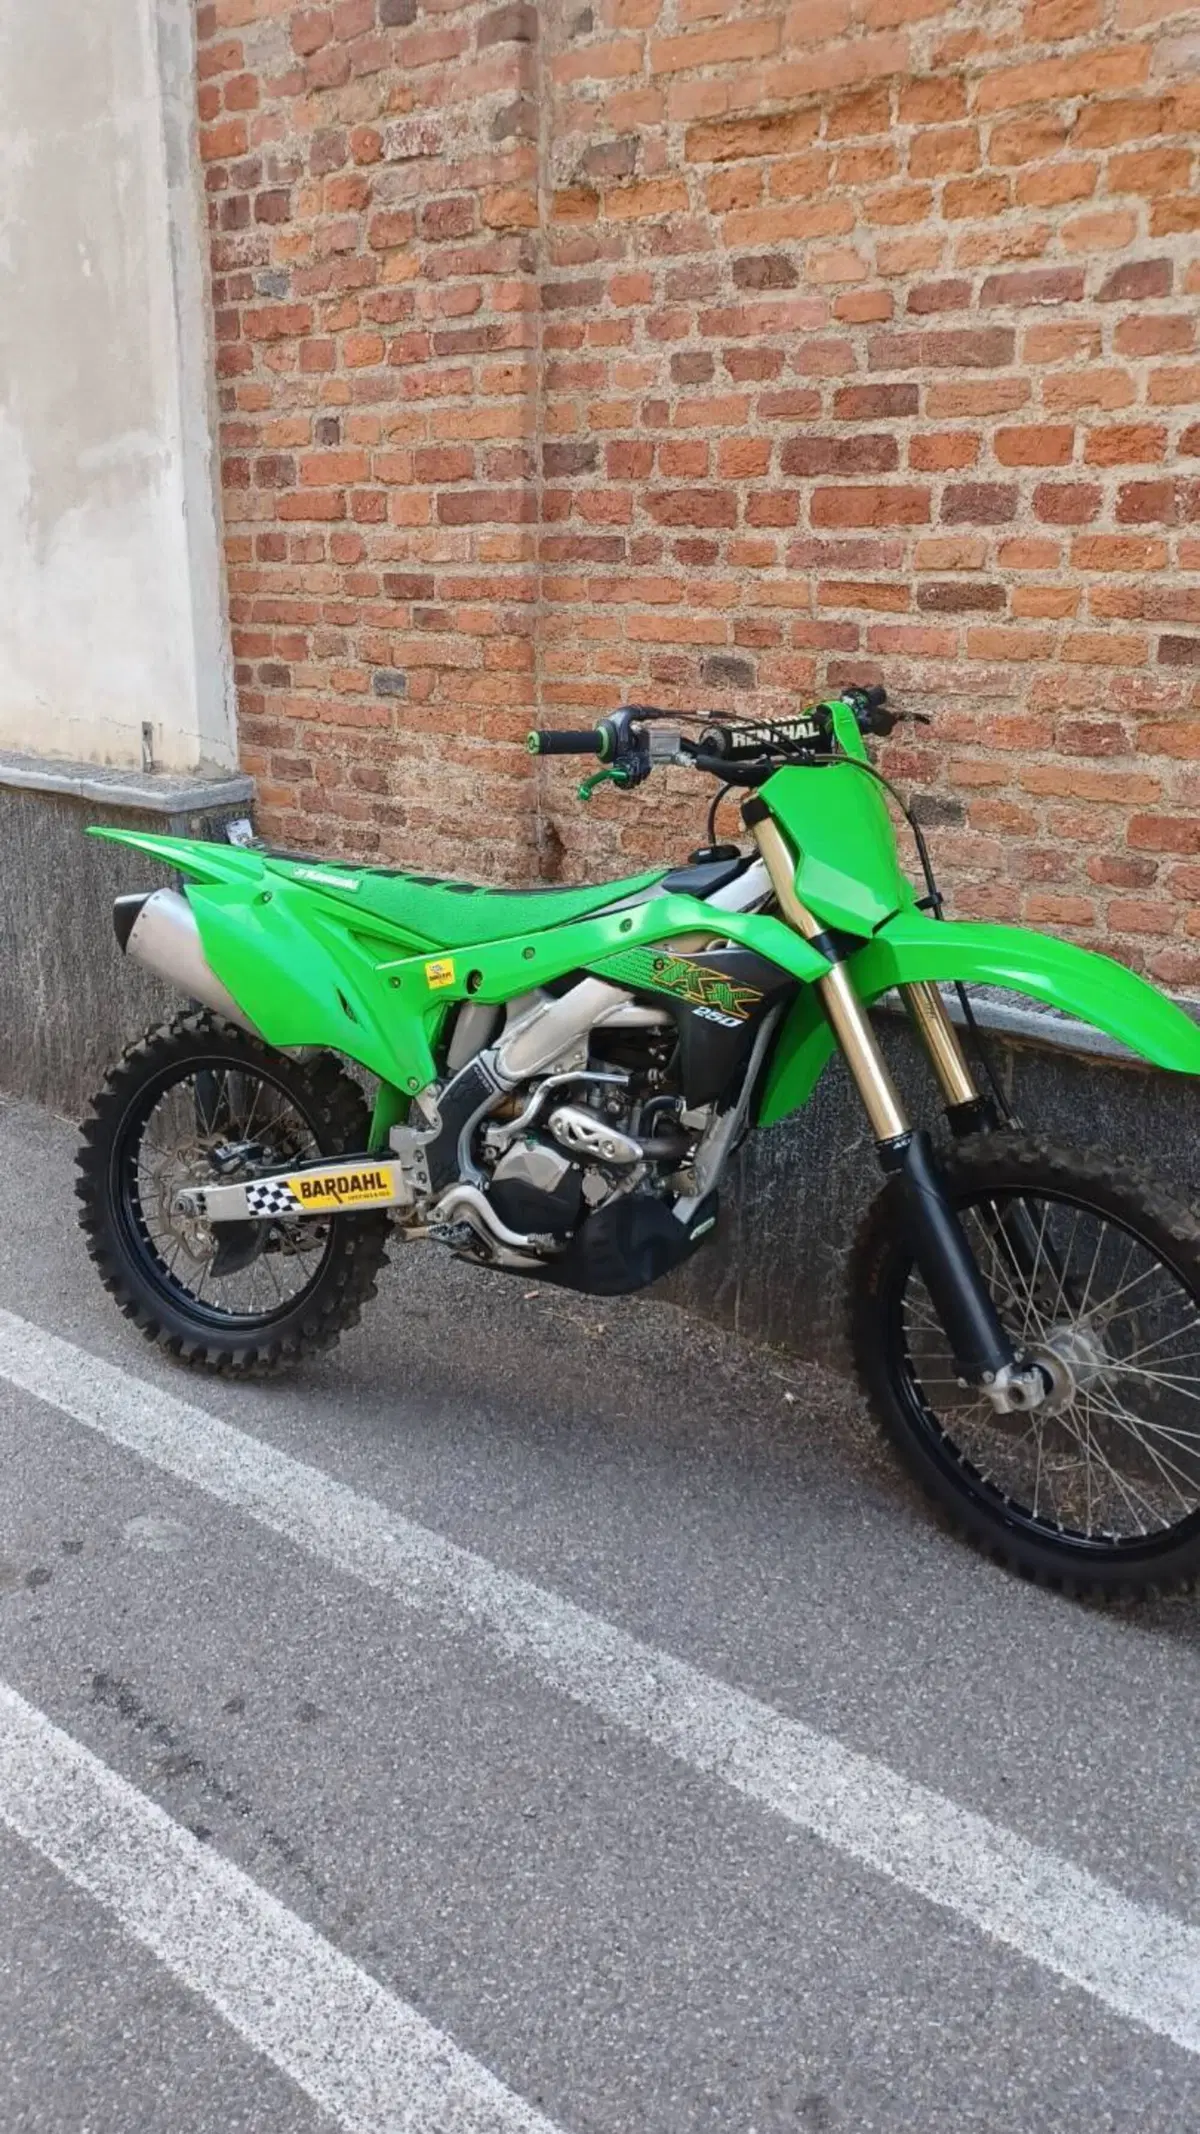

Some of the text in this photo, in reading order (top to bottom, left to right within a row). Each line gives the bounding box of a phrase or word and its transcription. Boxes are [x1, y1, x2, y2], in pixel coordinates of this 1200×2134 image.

[732, 721, 820, 748] RENTHAL
[691, 1006, 744, 1028] 250
[300, 1171, 388, 1204] BARDAHL
